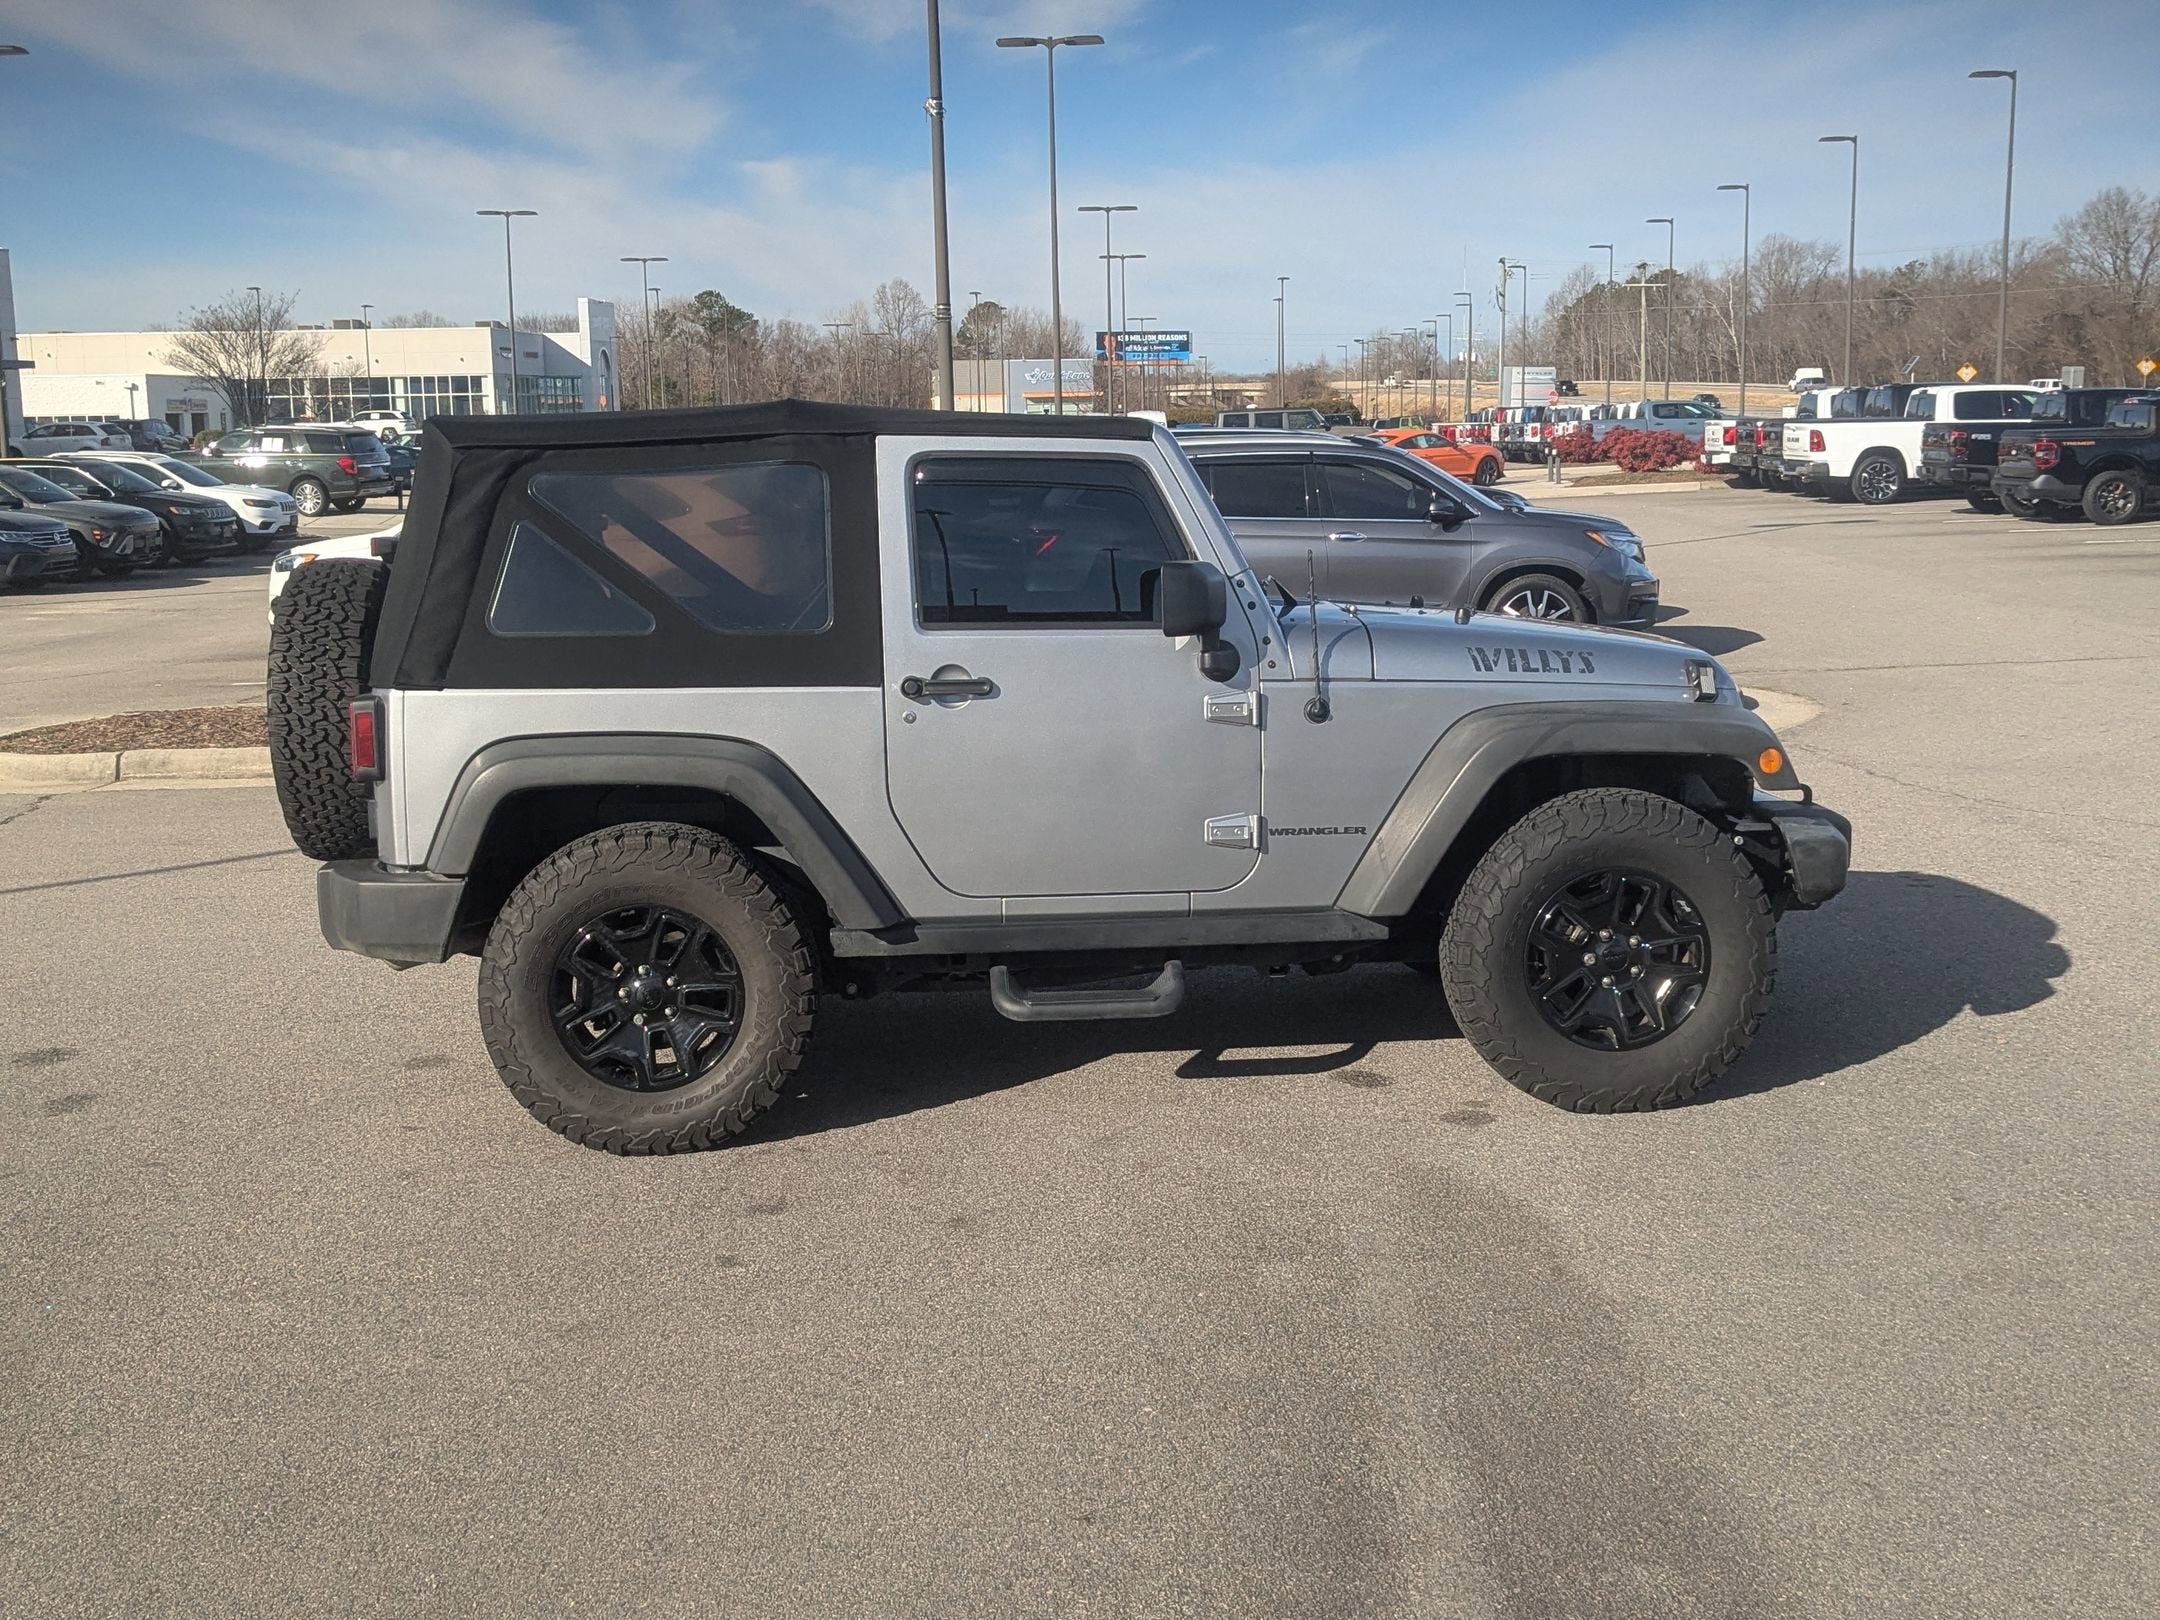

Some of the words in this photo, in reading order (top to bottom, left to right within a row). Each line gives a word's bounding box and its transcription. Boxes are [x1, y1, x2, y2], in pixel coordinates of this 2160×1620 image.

[1130, 334, 1157, 342] MILLION
[1464, 646, 1595, 674] WILLYS
[1268, 826, 1367, 836] WRANGLER
